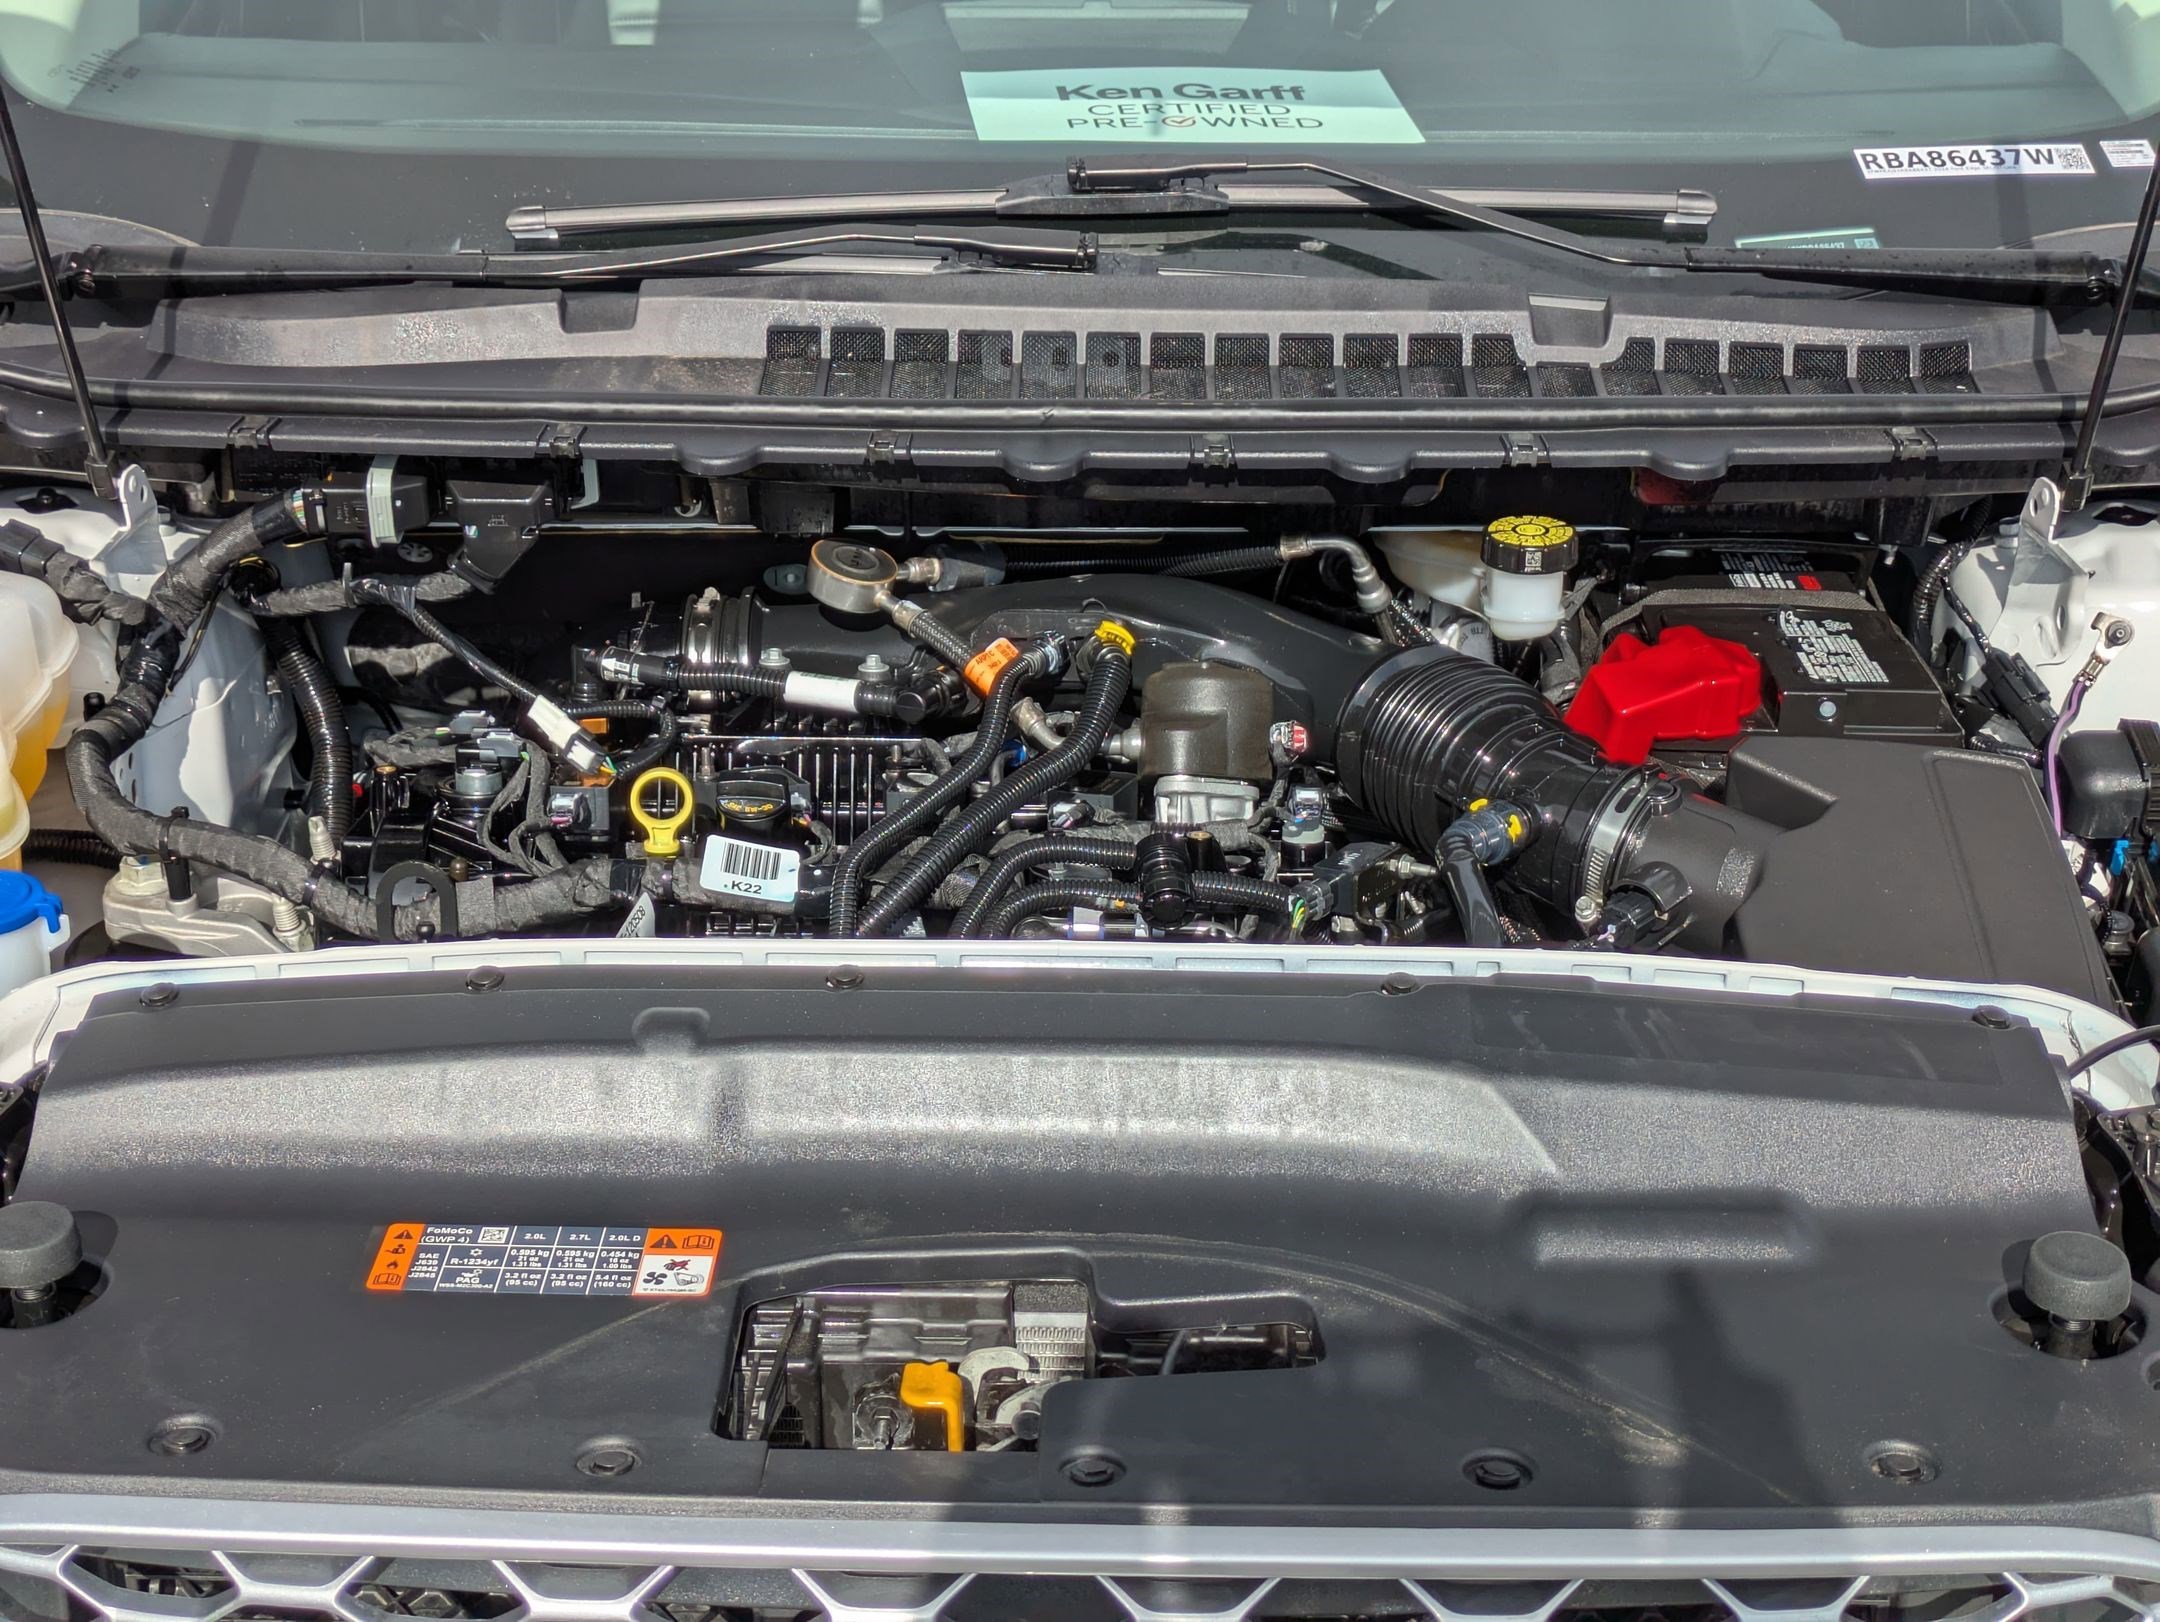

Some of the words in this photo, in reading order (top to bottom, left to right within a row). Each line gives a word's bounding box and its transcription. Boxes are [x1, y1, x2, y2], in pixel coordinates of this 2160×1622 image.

[1056, 84, 1163, 101] Ken
[1173, 83, 1305, 101] Garff
[1088, 103, 1291, 116] CERTIFIED
[1860, 148, 2054, 170] RBA86437W
[457, 1236, 470, 1244] 4)
[583, 1250, 595, 1258] kg
[628, 1251, 640, 1259] kg
[450, 1258, 499, 1266] R-1234yf
